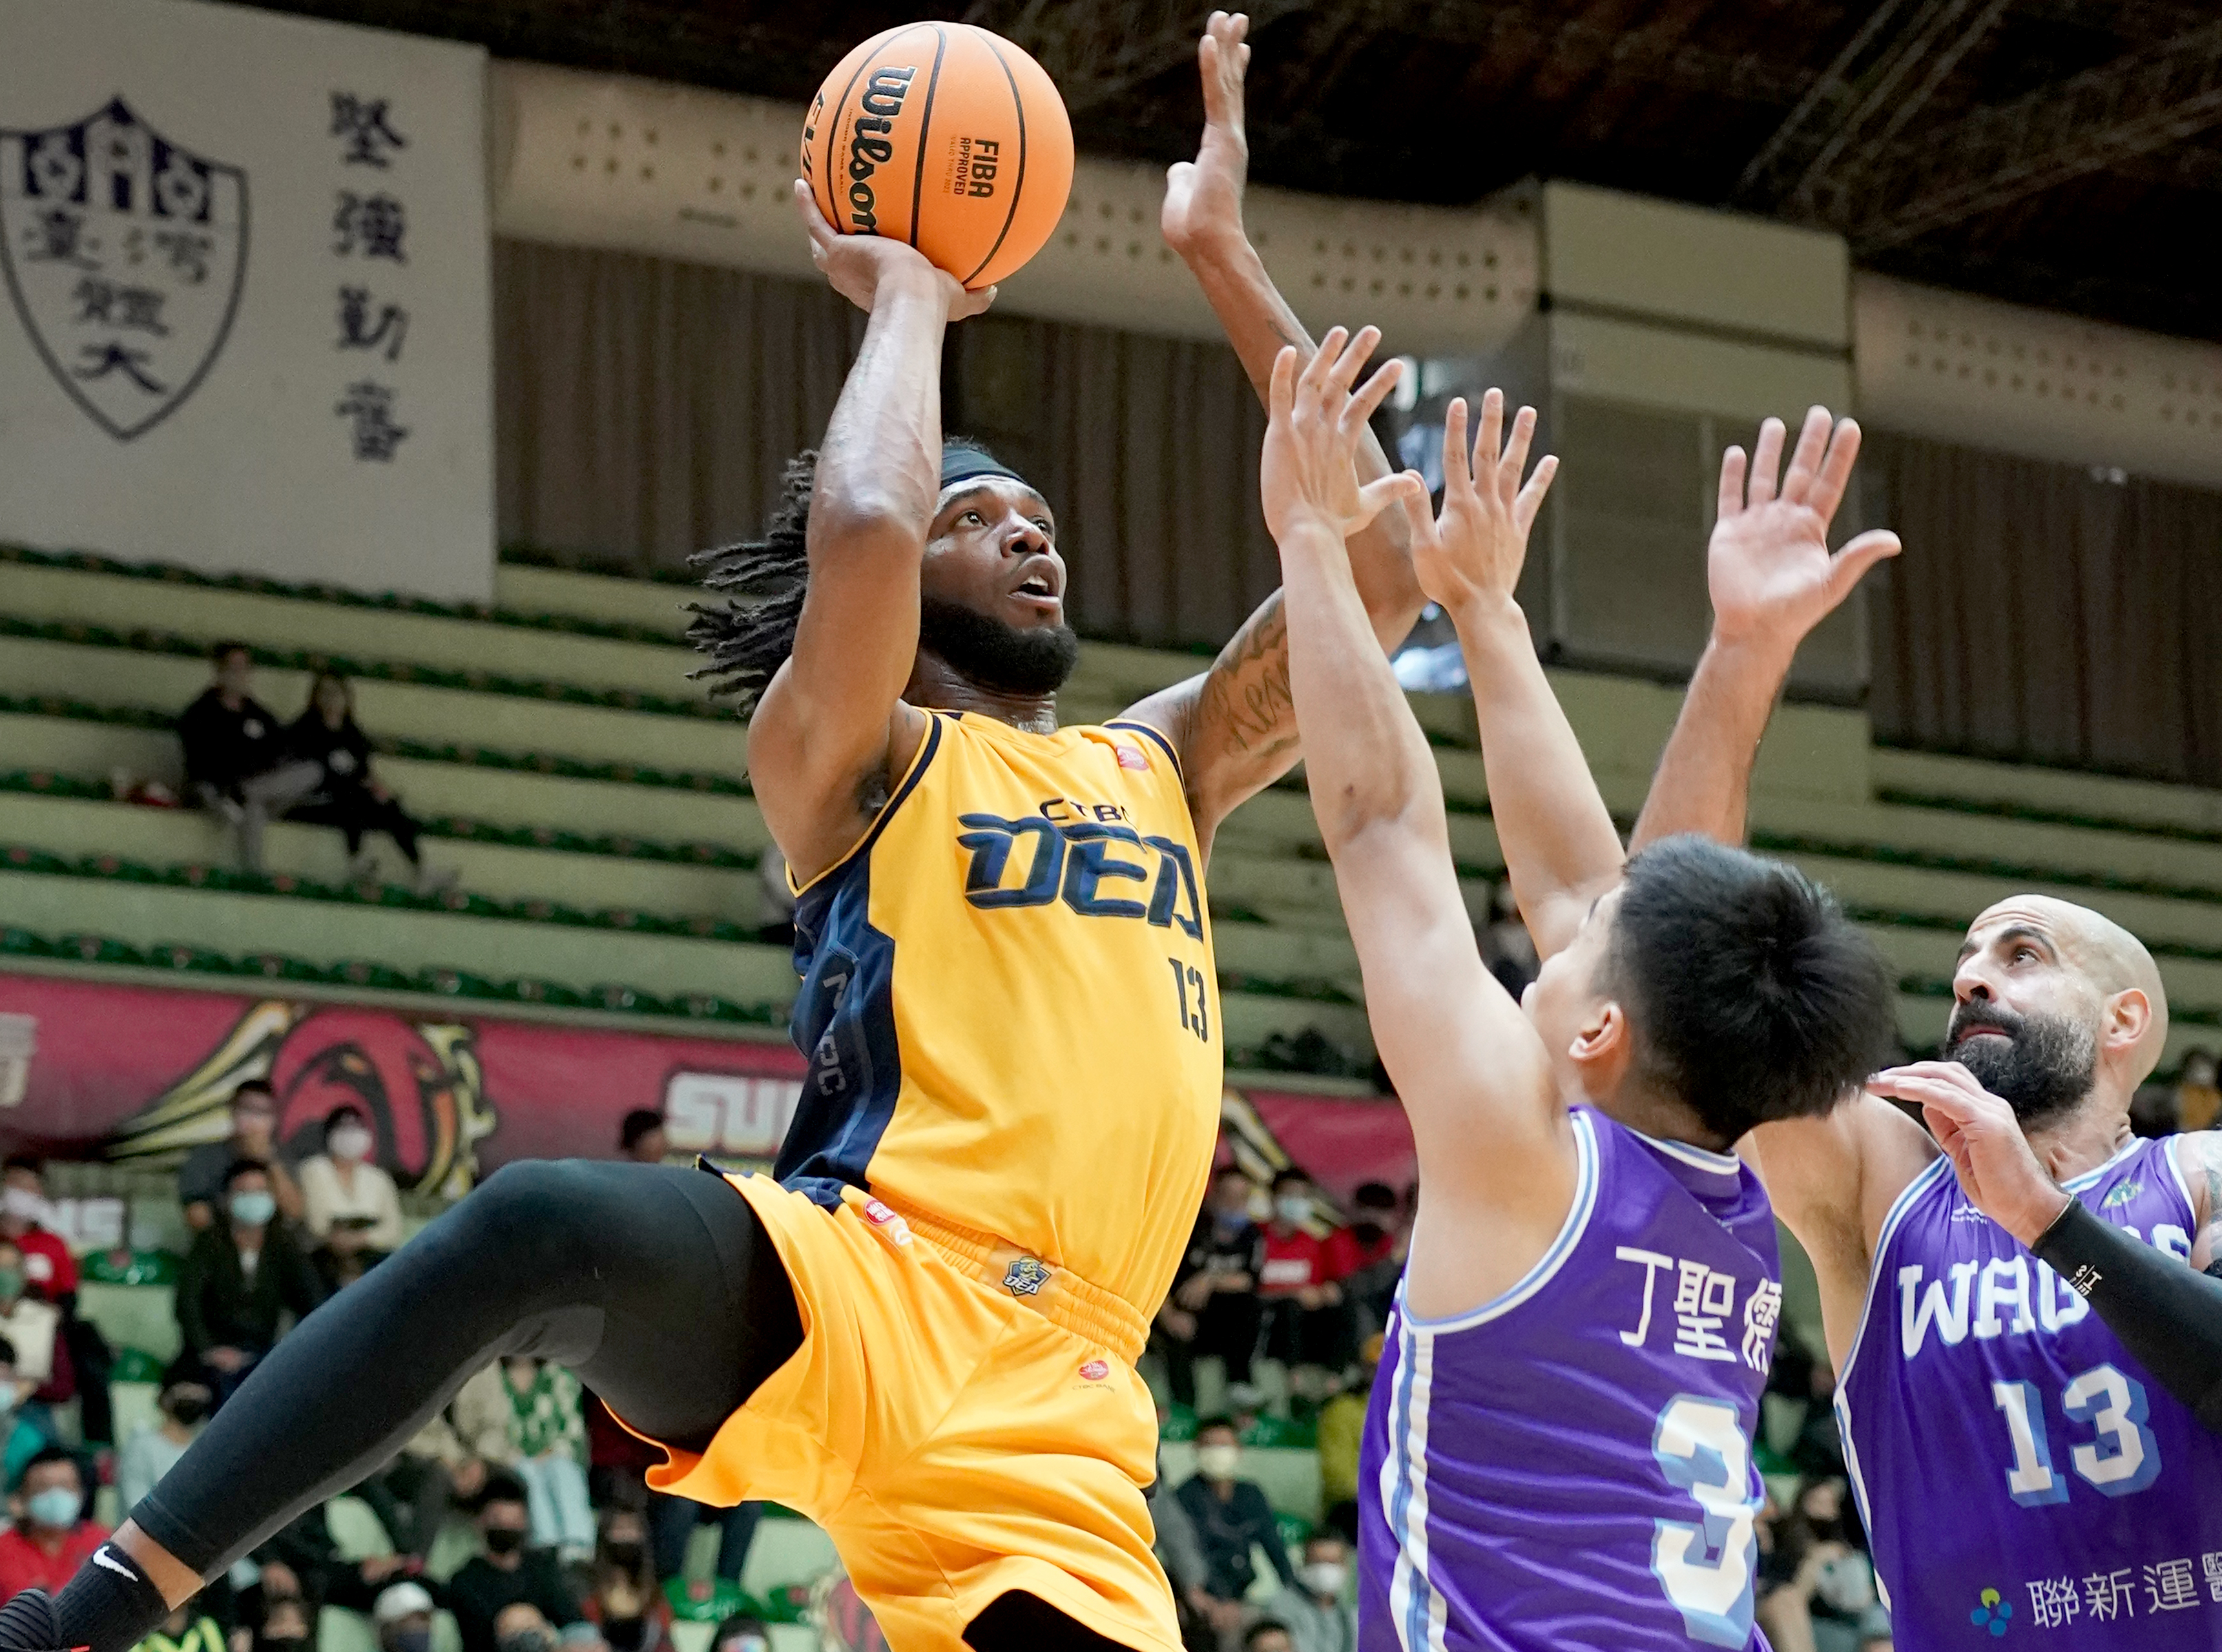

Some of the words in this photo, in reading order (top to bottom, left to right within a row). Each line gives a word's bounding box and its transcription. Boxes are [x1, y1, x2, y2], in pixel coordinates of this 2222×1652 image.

[848, 65, 918, 235] Wilson
[953, 138, 971, 194] APPROVED
[968, 139, 999, 198] FIBA
[1168, 957, 1208, 1043] 13
[1993, 1363, 2157, 1503] 13
[1652, 1395, 1760, 1631] 3
